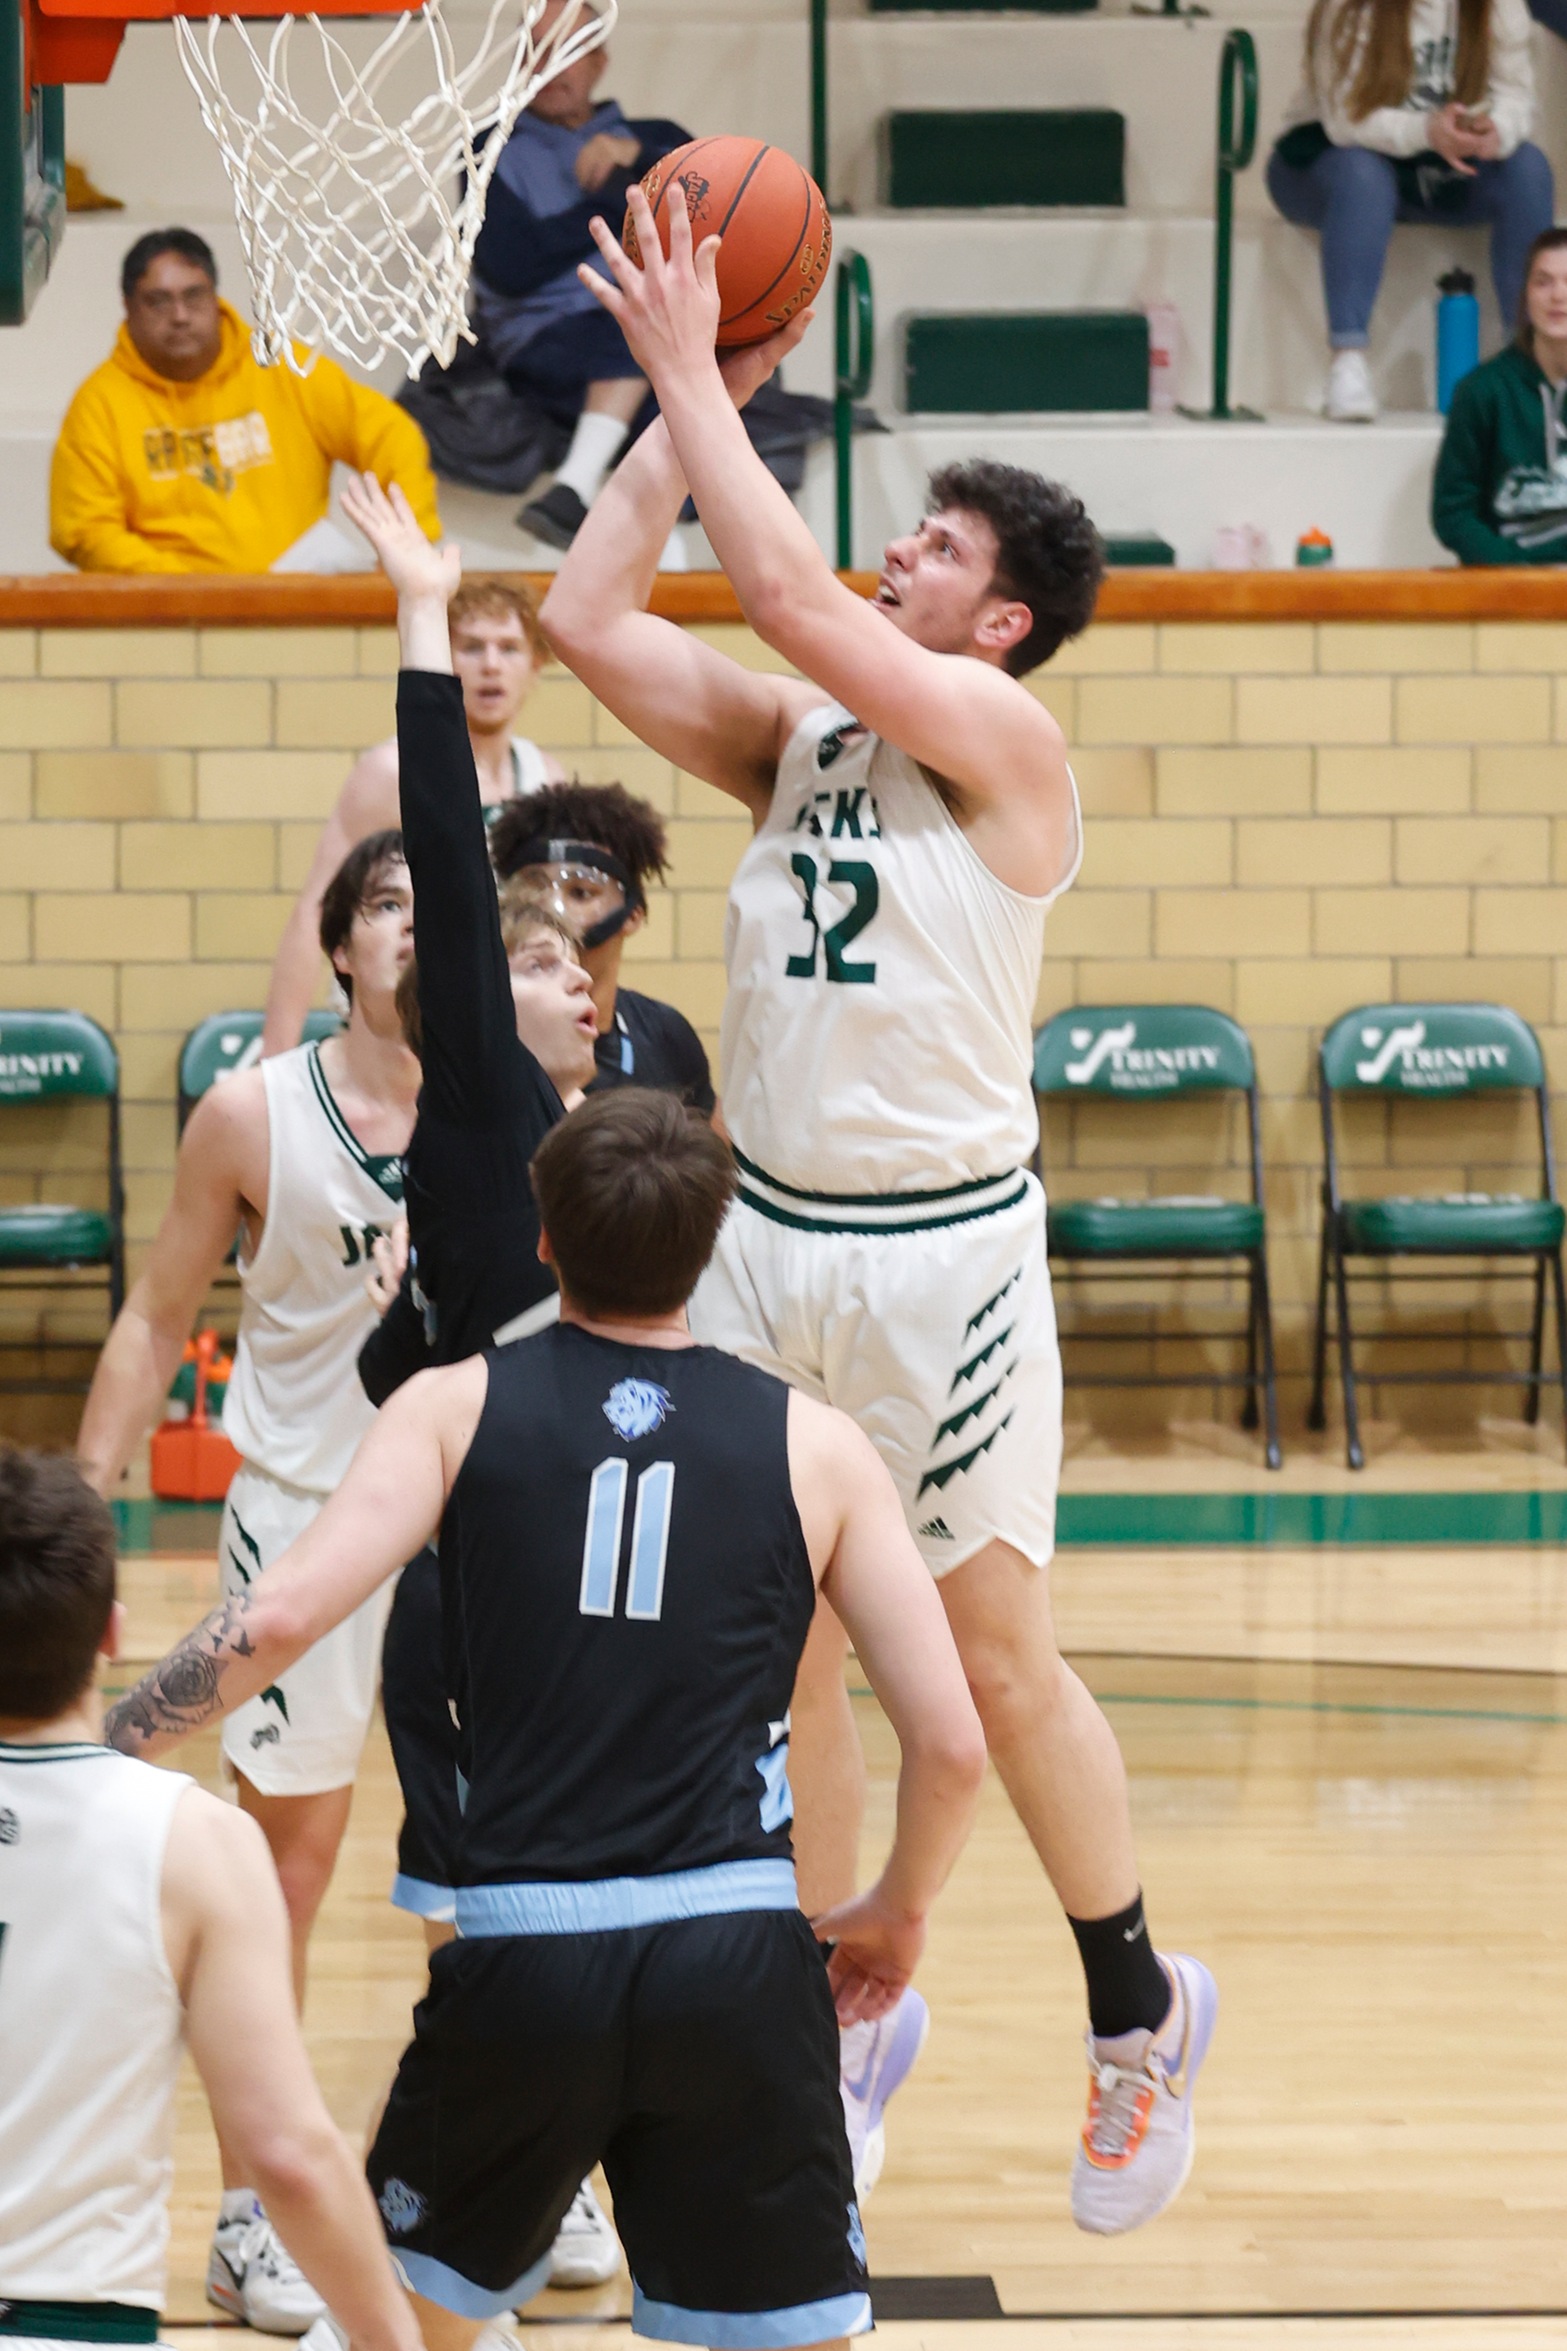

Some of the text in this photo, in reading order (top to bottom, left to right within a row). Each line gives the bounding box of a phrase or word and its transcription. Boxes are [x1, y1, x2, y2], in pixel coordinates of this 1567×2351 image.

[1112, 1046, 1220, 1071] TRINITY
[1401, 1045, 1509, 1069] TRINITY
[579, 1456, 676, 1622] 11
